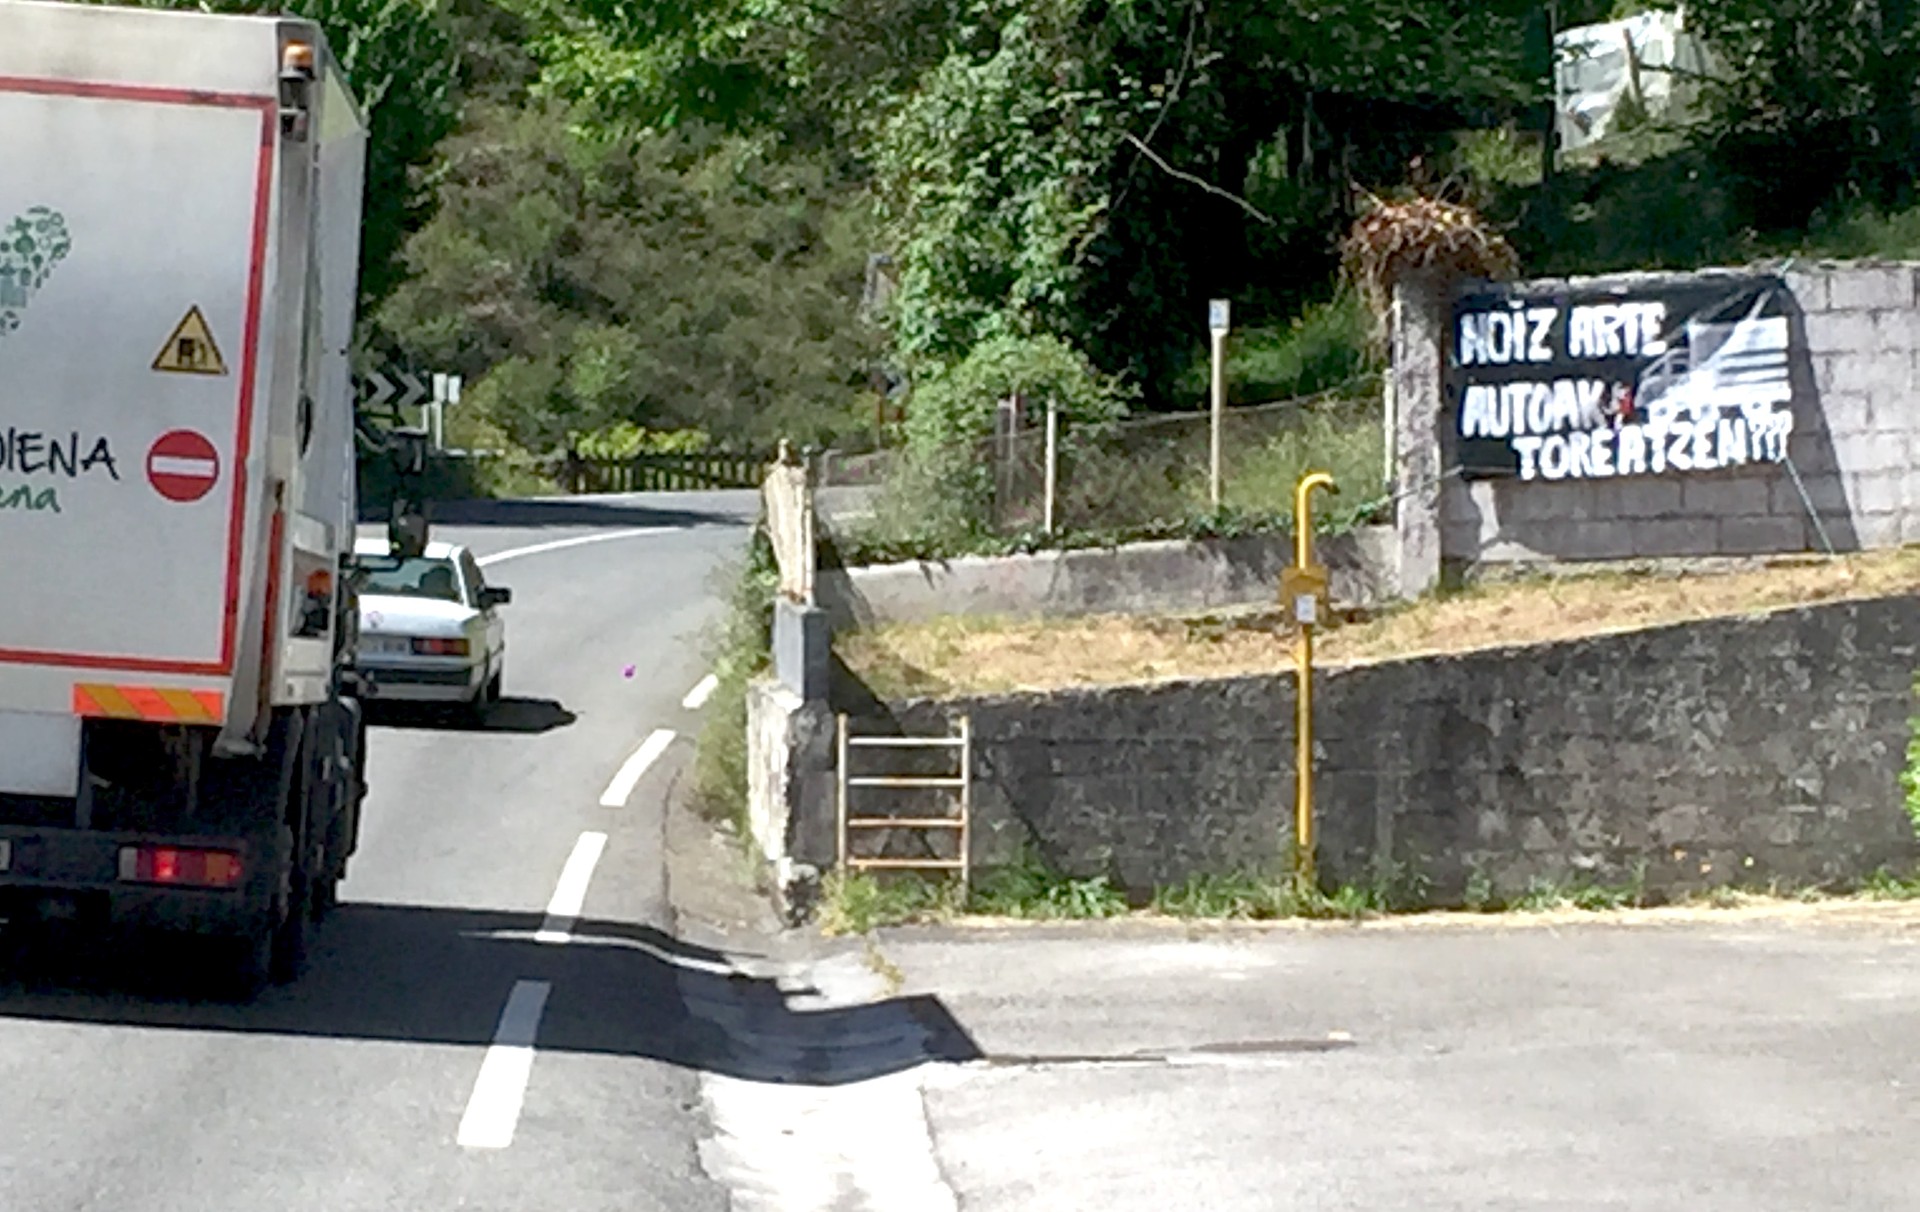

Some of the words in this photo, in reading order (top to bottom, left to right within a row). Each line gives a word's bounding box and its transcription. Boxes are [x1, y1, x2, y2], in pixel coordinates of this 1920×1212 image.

[1568, 302, 1667, 357] ARTE
[1462, 378, 1607, 438] AUTOAK
[0, 426, 120, 481] IENA
